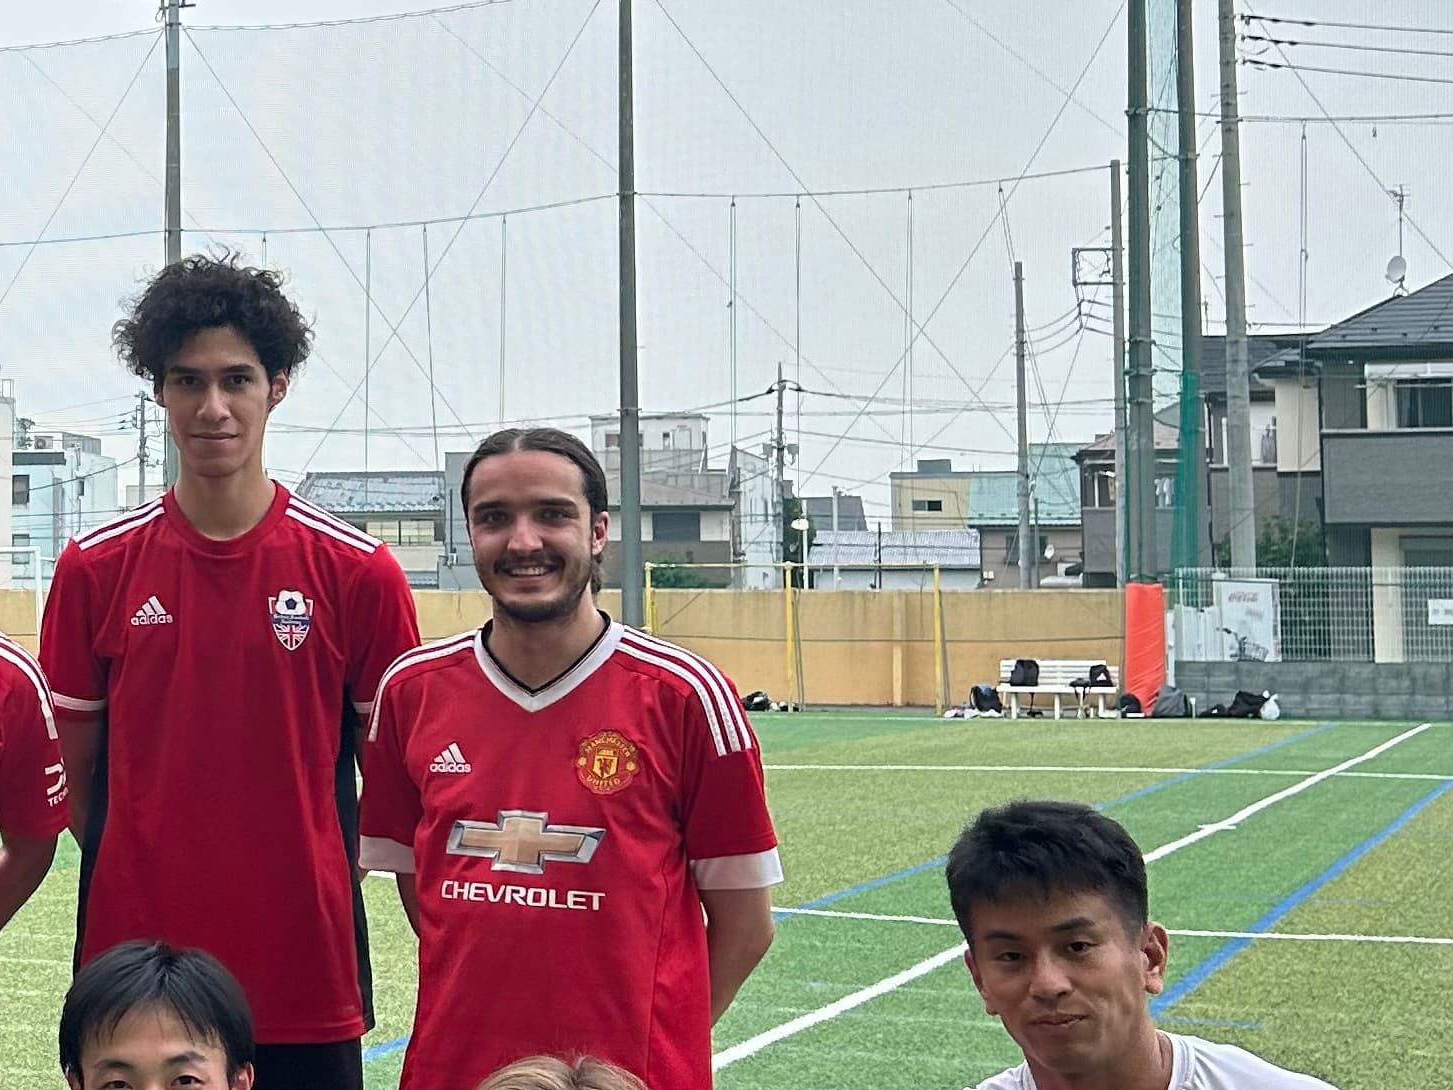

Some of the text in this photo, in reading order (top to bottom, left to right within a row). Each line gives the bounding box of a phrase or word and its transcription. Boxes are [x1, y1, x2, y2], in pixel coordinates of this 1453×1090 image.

[131, 613, 173, 626] adidas
[429, 761, 472, 774] adidas
[586, 774, 621, 787] UNITED
[441, 880, 606, 911] CHEVROLET
